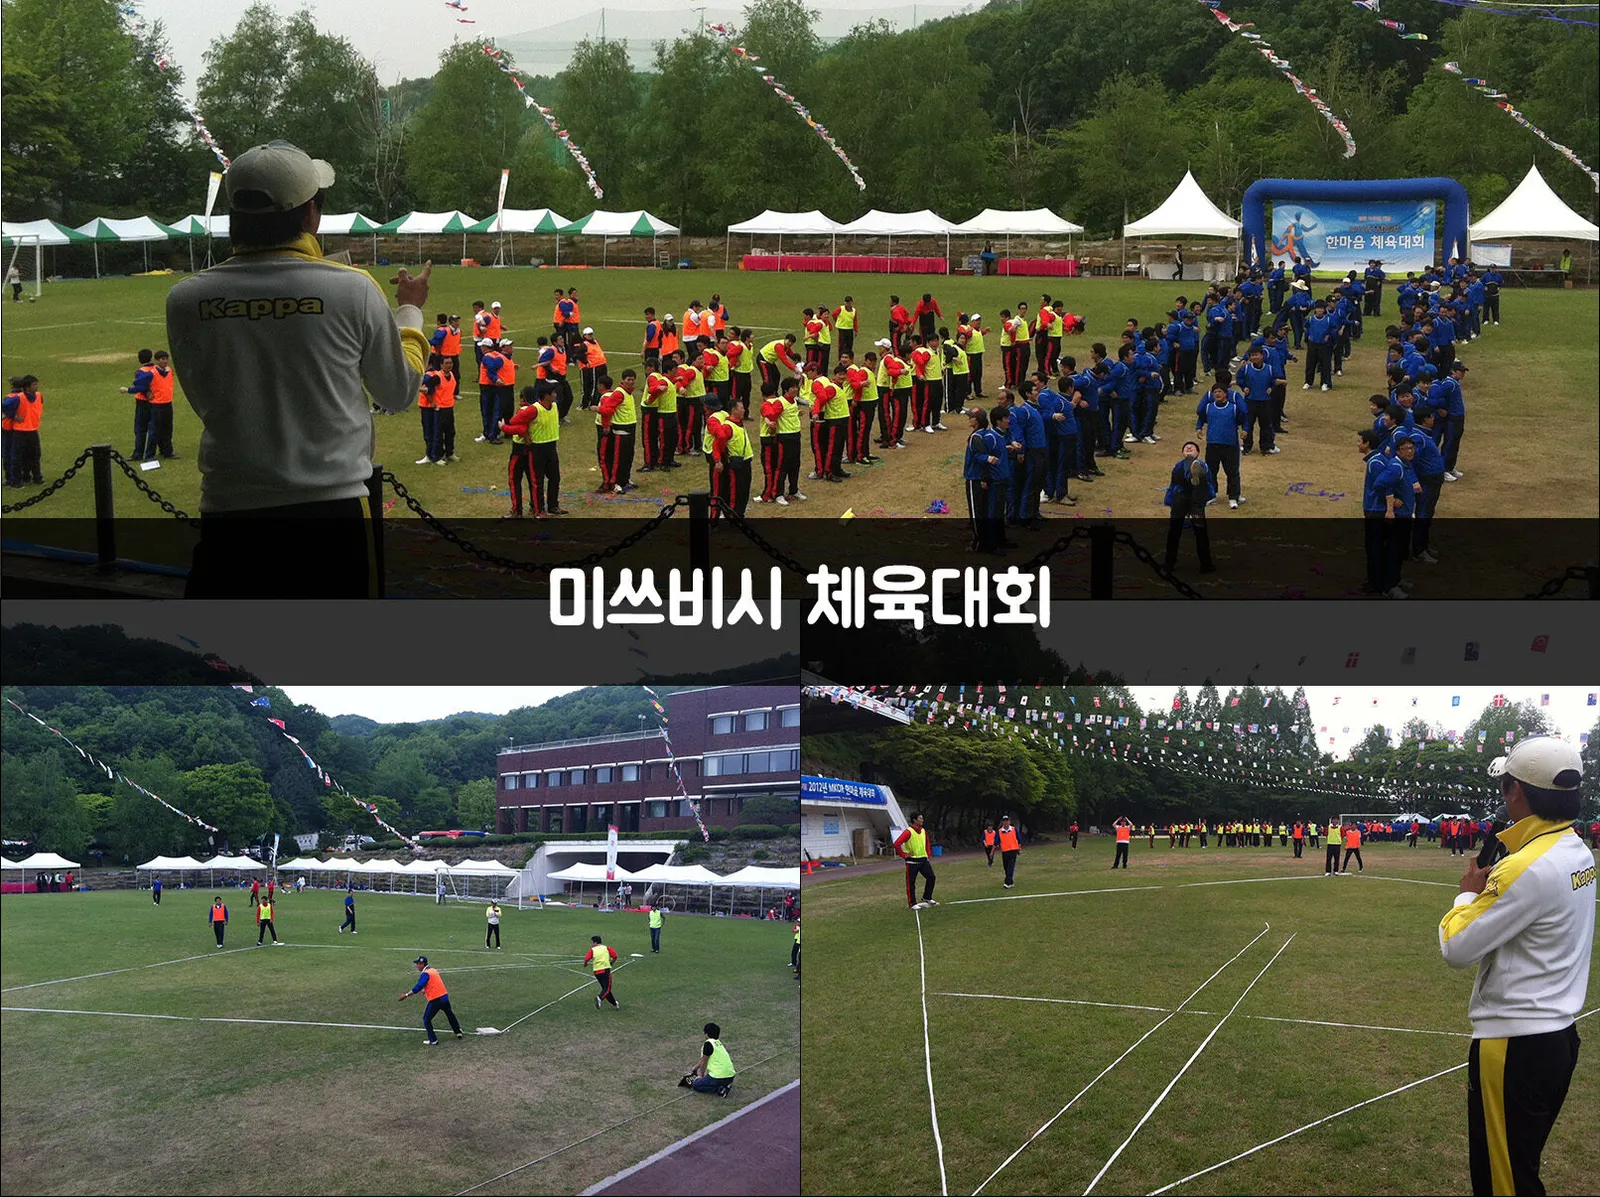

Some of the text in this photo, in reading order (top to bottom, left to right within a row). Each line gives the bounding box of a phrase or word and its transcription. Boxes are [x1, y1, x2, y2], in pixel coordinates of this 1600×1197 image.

[1325, 234, 1425, 250] 한마음 체육대회
[200, 296, 324, 322] Kappa
[1571, 866, 1596, 891] Kapp
